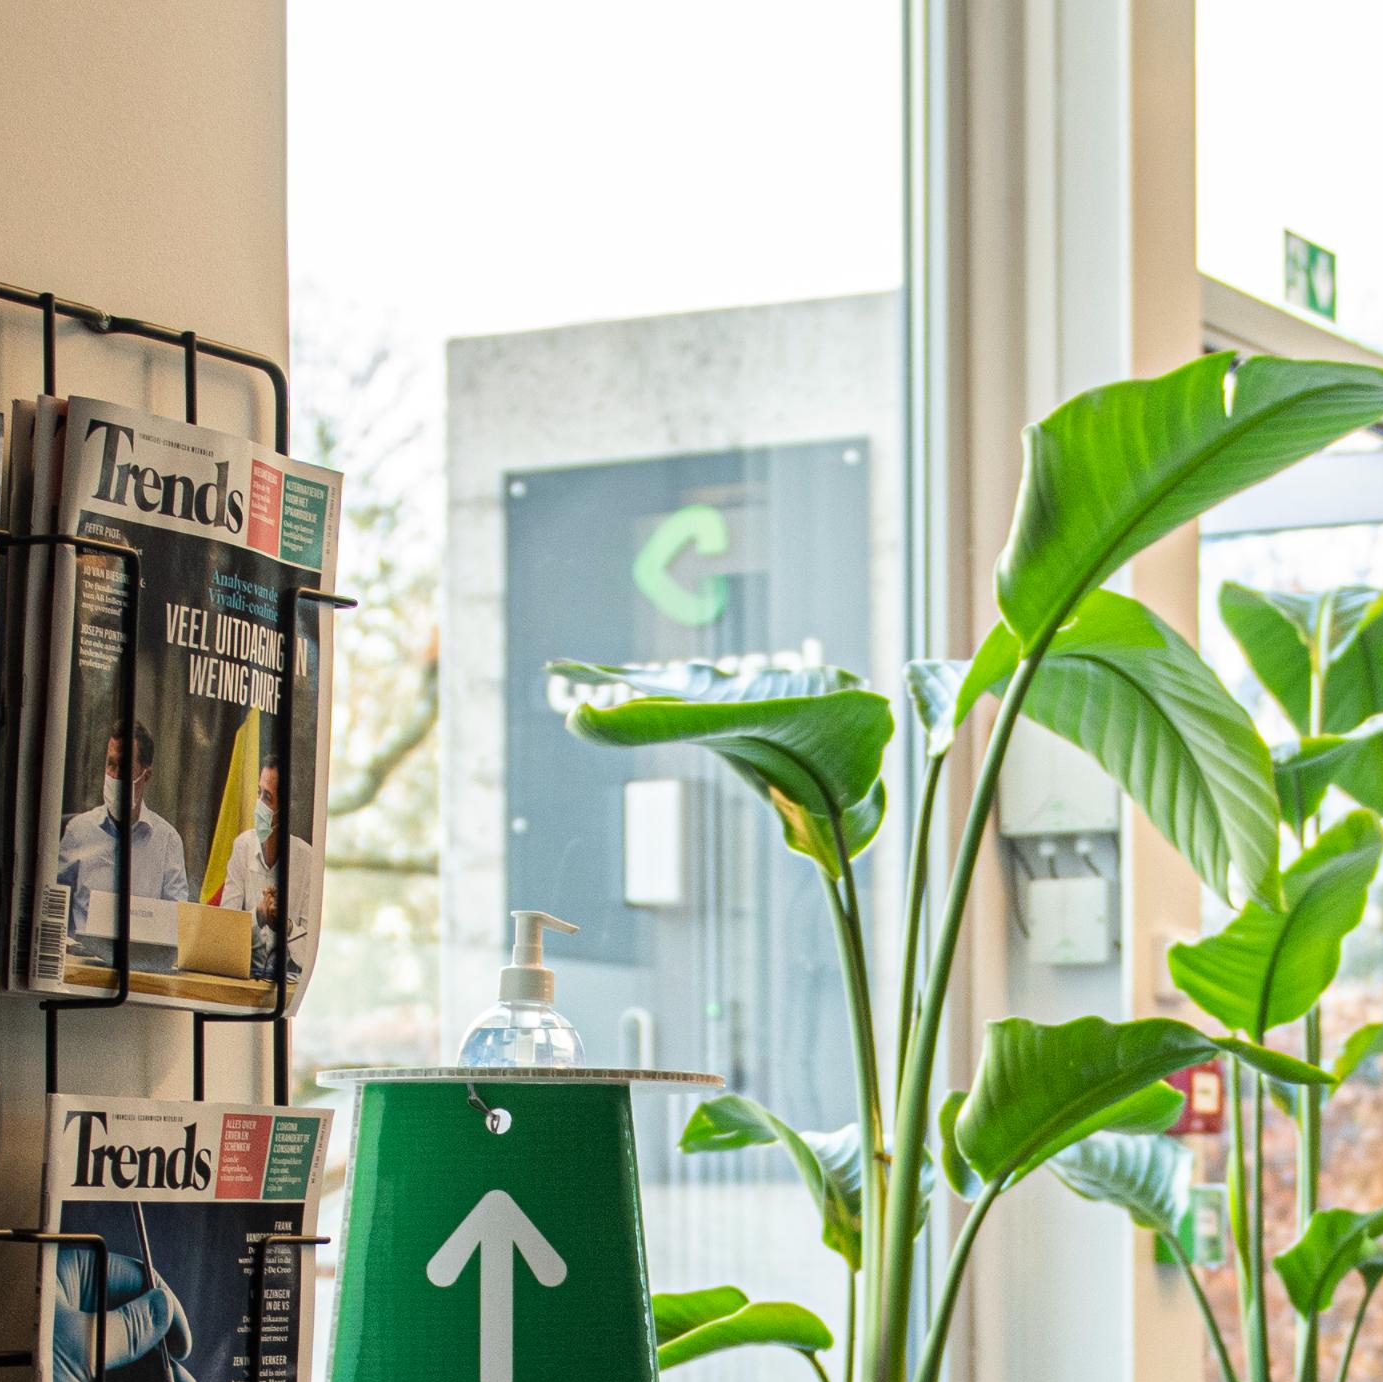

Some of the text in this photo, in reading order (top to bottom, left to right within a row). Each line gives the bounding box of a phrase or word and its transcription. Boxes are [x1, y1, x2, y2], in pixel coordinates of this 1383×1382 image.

[84, 418, 244, 535] Trends
[211, 570, 253, 595] Analyse
[166, 602, 308, 678] VEEL UITDAGINGN
[189, 653, 283, 716] WEINIG DURF
[63, 1110, 212, 1190] Trends
